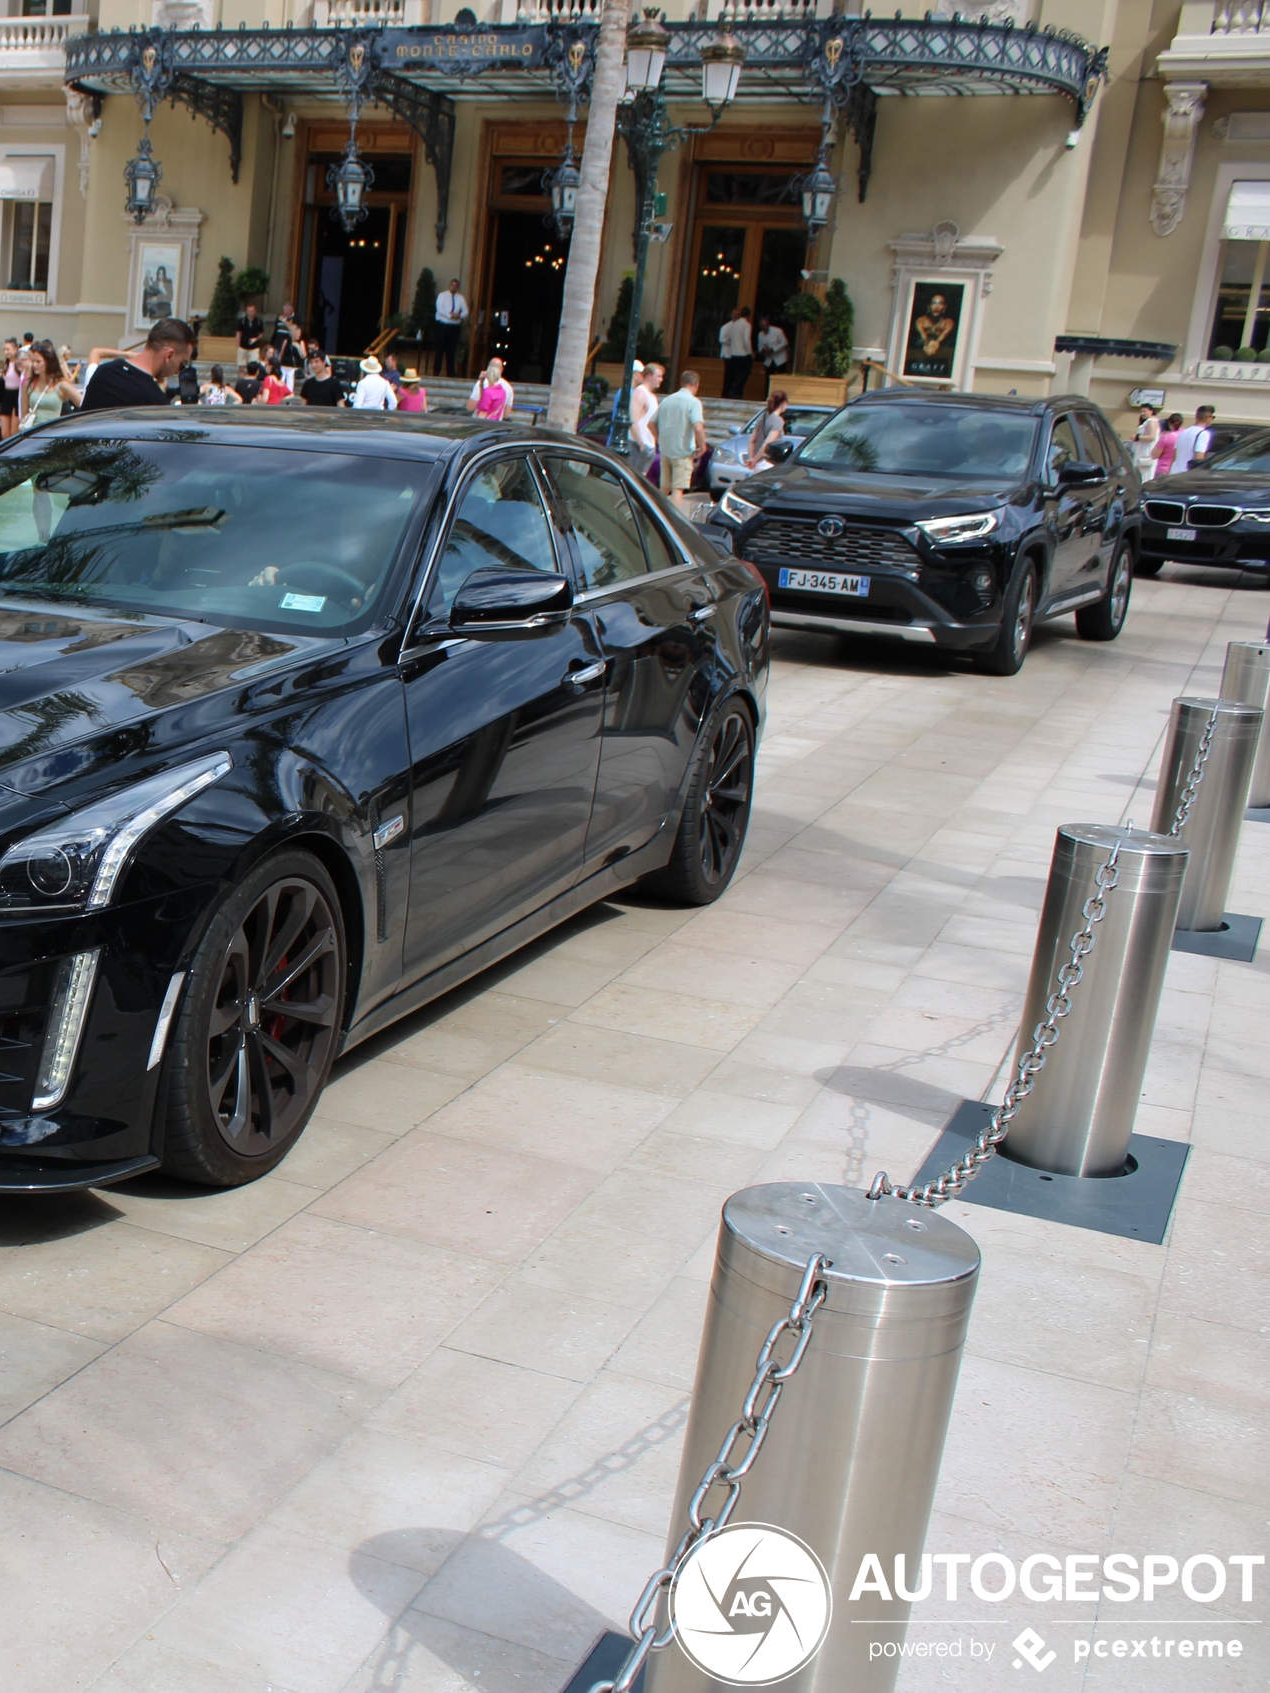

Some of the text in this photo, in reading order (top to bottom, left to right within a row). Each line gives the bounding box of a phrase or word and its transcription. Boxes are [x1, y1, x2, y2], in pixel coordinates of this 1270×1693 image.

[434, 34, 498, 46] CASINO
[911, 361, 946, 371] GRAFF
[788, 572, 860, 593] FJ-345-AM
